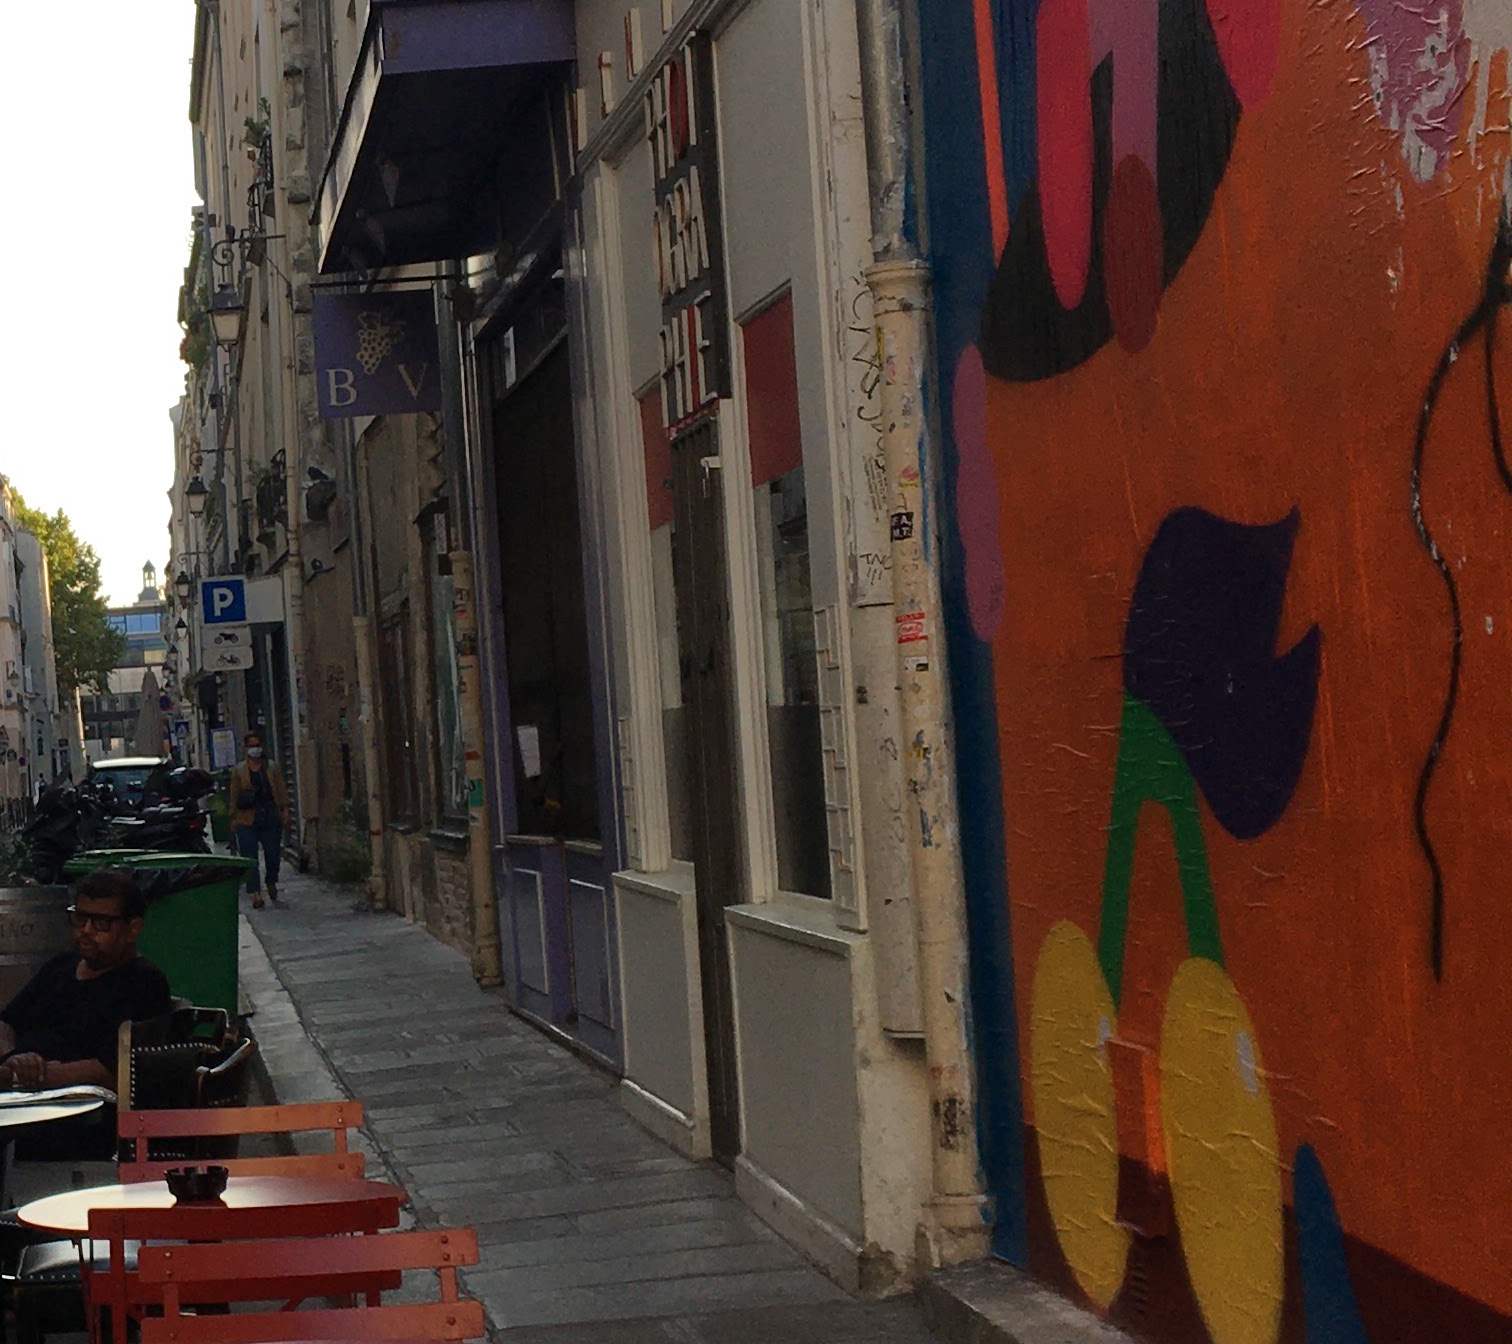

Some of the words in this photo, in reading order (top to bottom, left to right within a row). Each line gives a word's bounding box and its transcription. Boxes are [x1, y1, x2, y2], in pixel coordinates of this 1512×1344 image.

[326, 368, 358, 407] B
[396, 360, 429, 400] V
[212, 587, 235, 617] P
